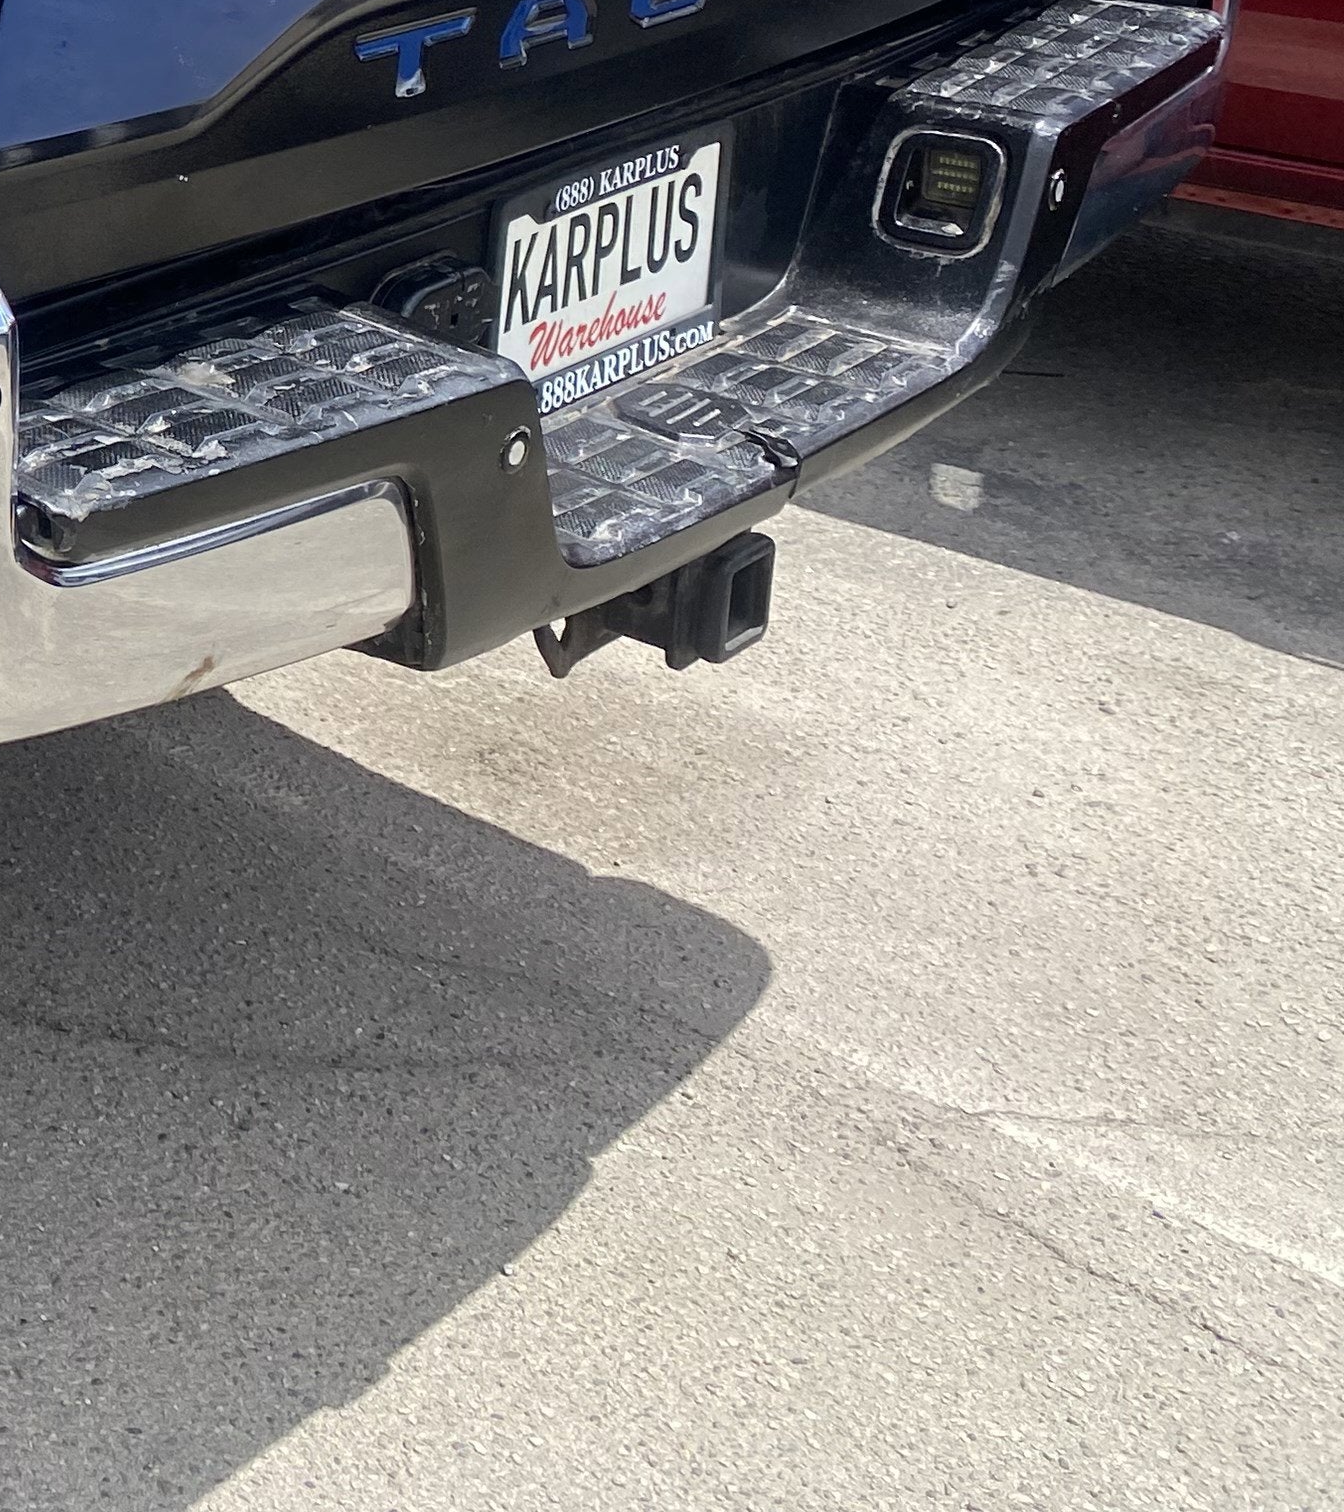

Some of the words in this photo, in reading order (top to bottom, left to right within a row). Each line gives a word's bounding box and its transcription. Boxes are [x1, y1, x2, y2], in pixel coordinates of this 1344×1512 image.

[555, 176, 596, 212] (888)
[598, 144, 681, 196] KARPLUS
[503, 172, 703, 335] KARPLUS
[528, 290, 667, 371] Warehouse
